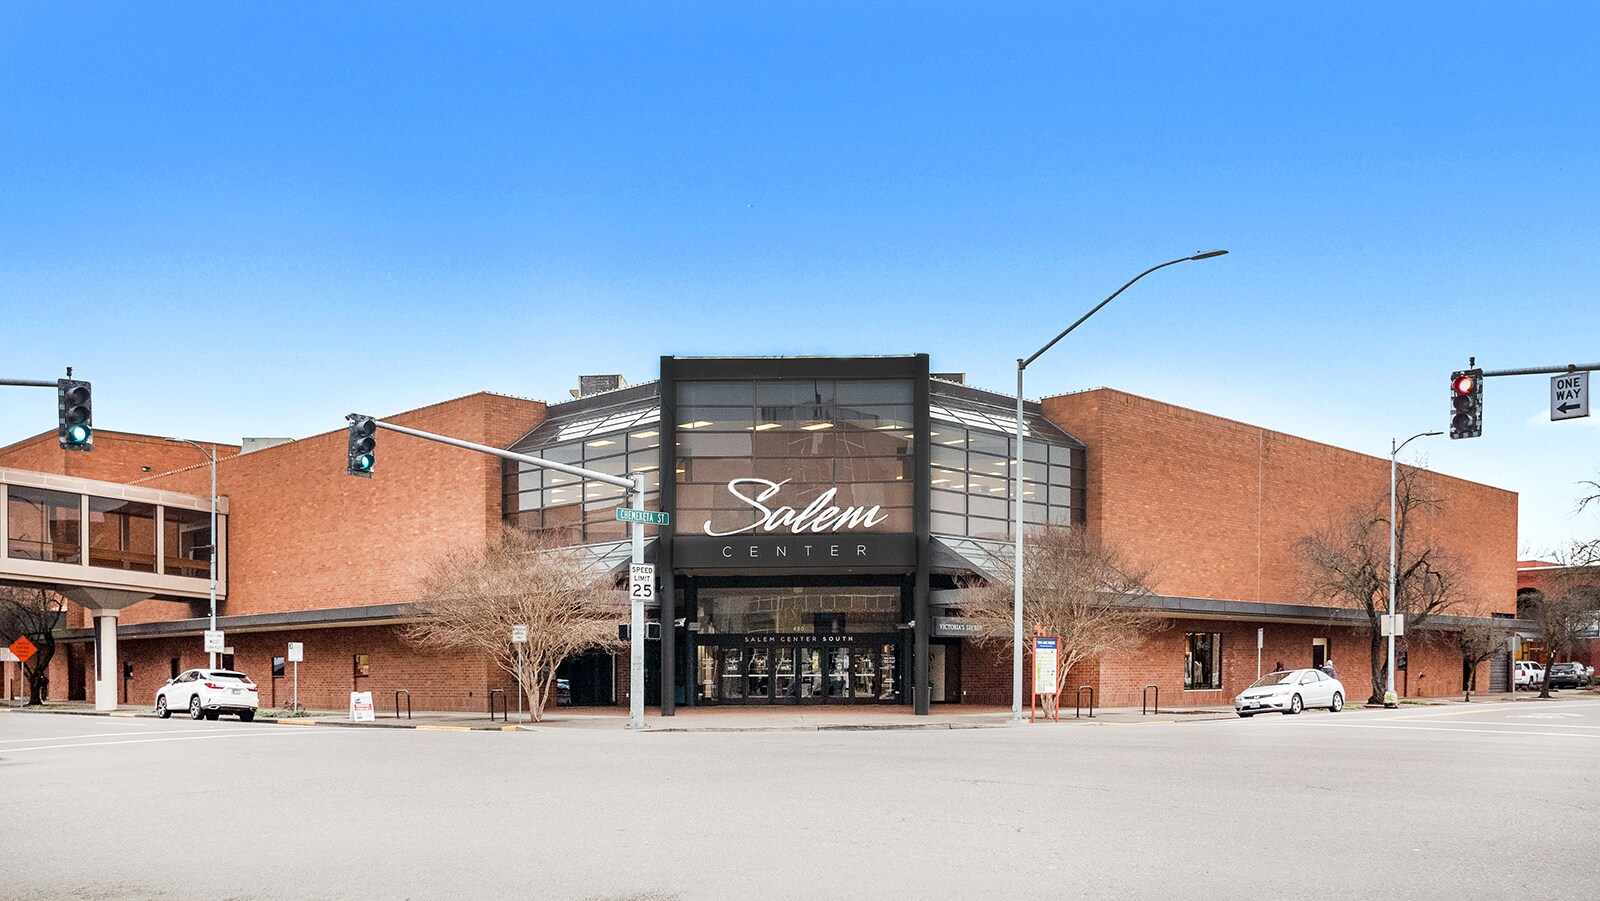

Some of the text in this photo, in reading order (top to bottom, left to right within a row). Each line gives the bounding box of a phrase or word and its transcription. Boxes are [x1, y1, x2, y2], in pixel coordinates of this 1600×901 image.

[1557, 377, 1580, 389] ONE
[1556, 388, 1581, 401] WAY
[703, 477, 889, 537] Salem
[620, 509, 665, 523] CHEMEKETA ST
[722, 544, 867, 558] CENTER
[631, 566, 653, 574] SPEED
[632, 583, 652, 597] 25
